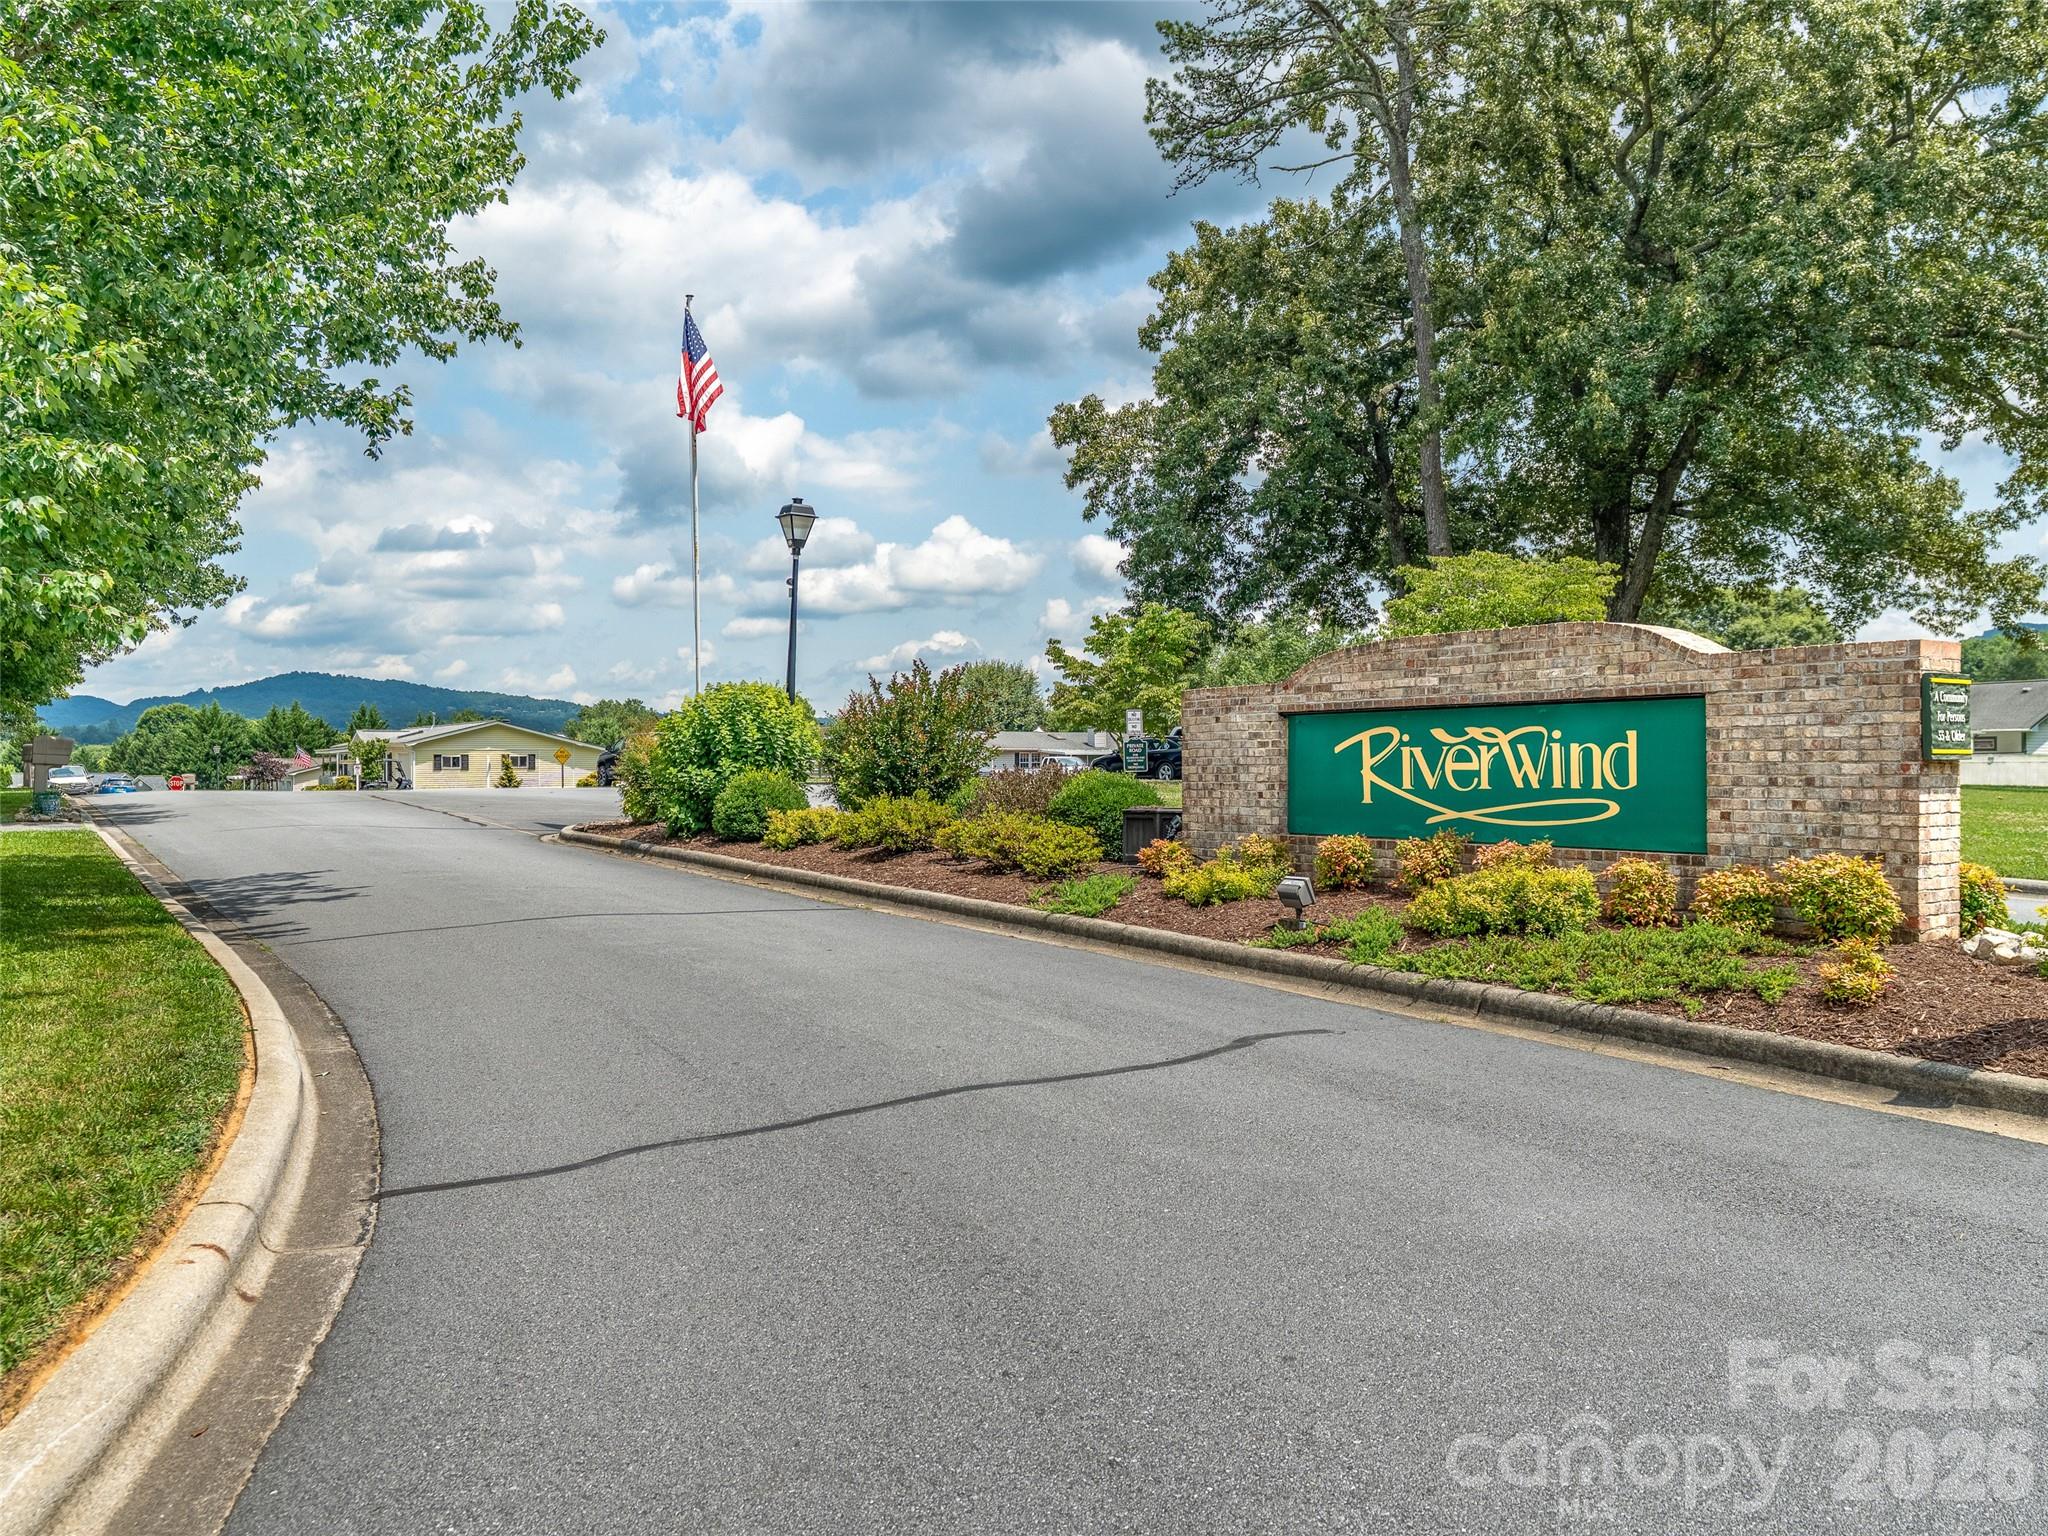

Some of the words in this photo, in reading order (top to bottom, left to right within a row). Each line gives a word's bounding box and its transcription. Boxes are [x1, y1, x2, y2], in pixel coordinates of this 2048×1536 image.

[1934, 690, 1939, 702] A
[1940, 690, 1968, 705] Community
[1937, 711, 1946, 722] For
[1947, 711, 1966, 722] Persons
[1937, 730, 1945, 741] 55
[1951, 730, 1966, 742] Older
